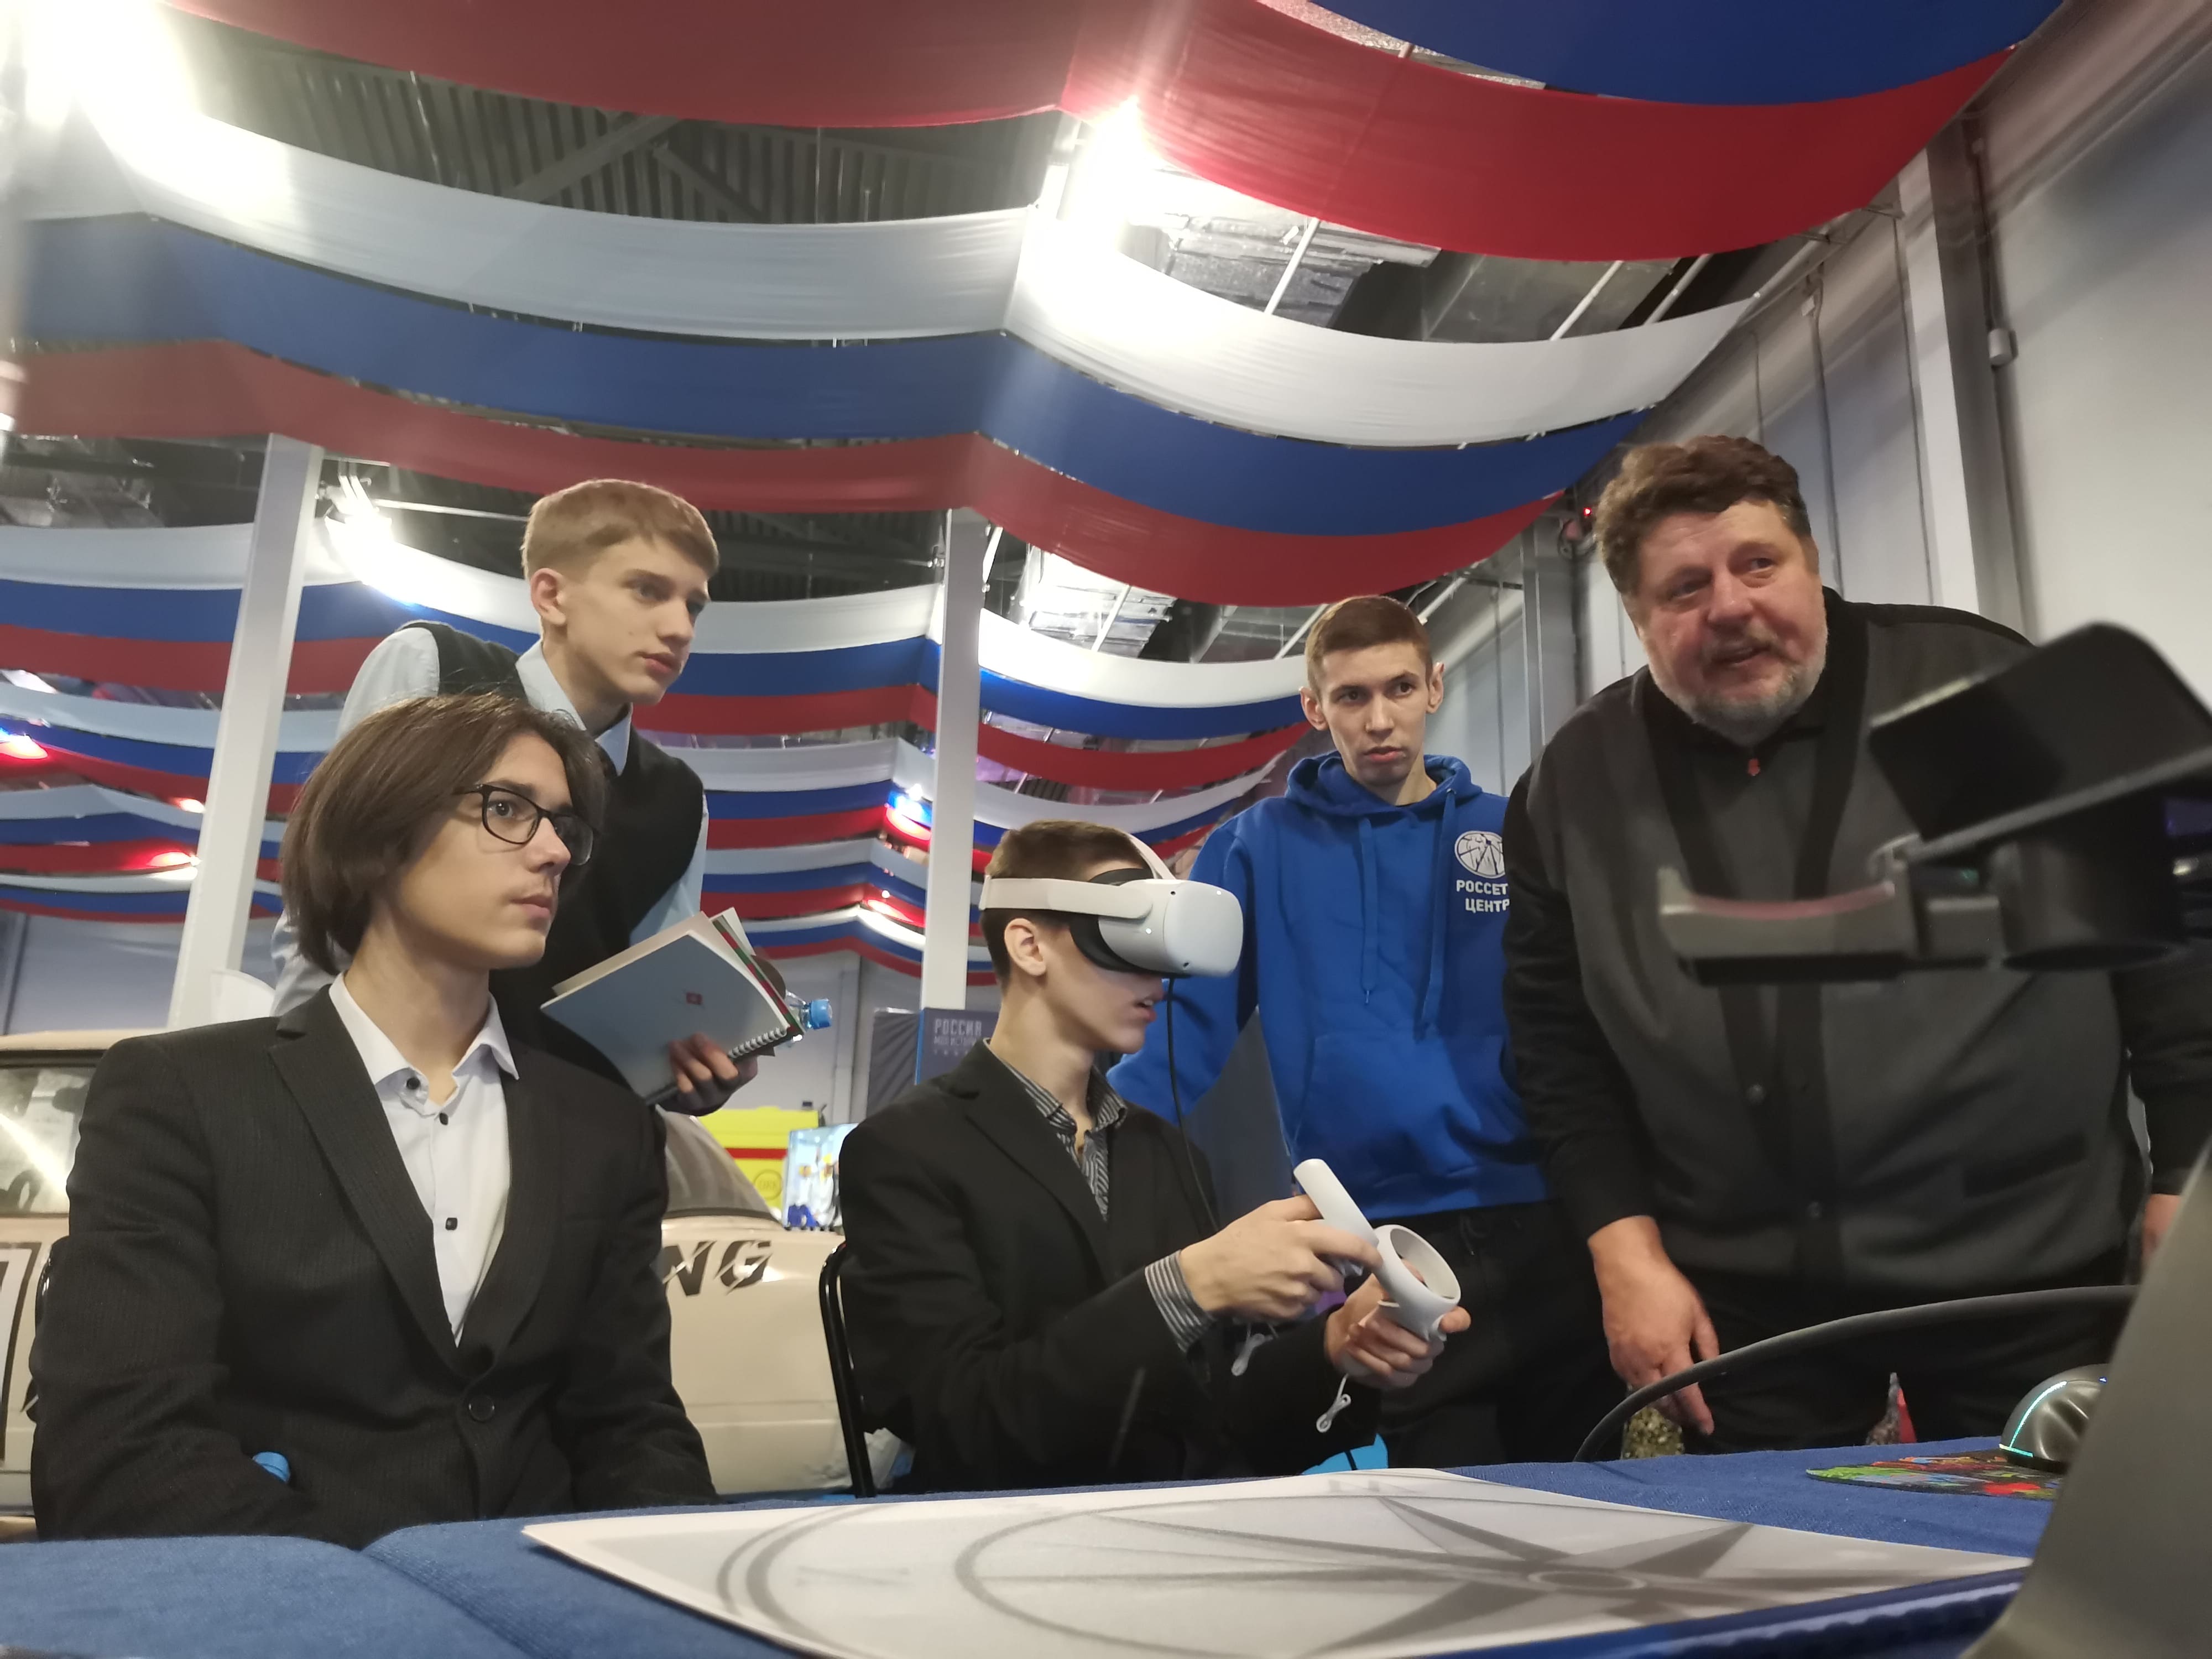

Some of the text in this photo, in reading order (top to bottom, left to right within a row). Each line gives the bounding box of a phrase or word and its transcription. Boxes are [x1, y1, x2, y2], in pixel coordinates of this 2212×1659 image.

[1456, 879, 1509, 895] РОССЕТ
[1465, 898, 1510, 914] ЦЕНТР
[934, 1018, 982, 1036] РОССИЯ
